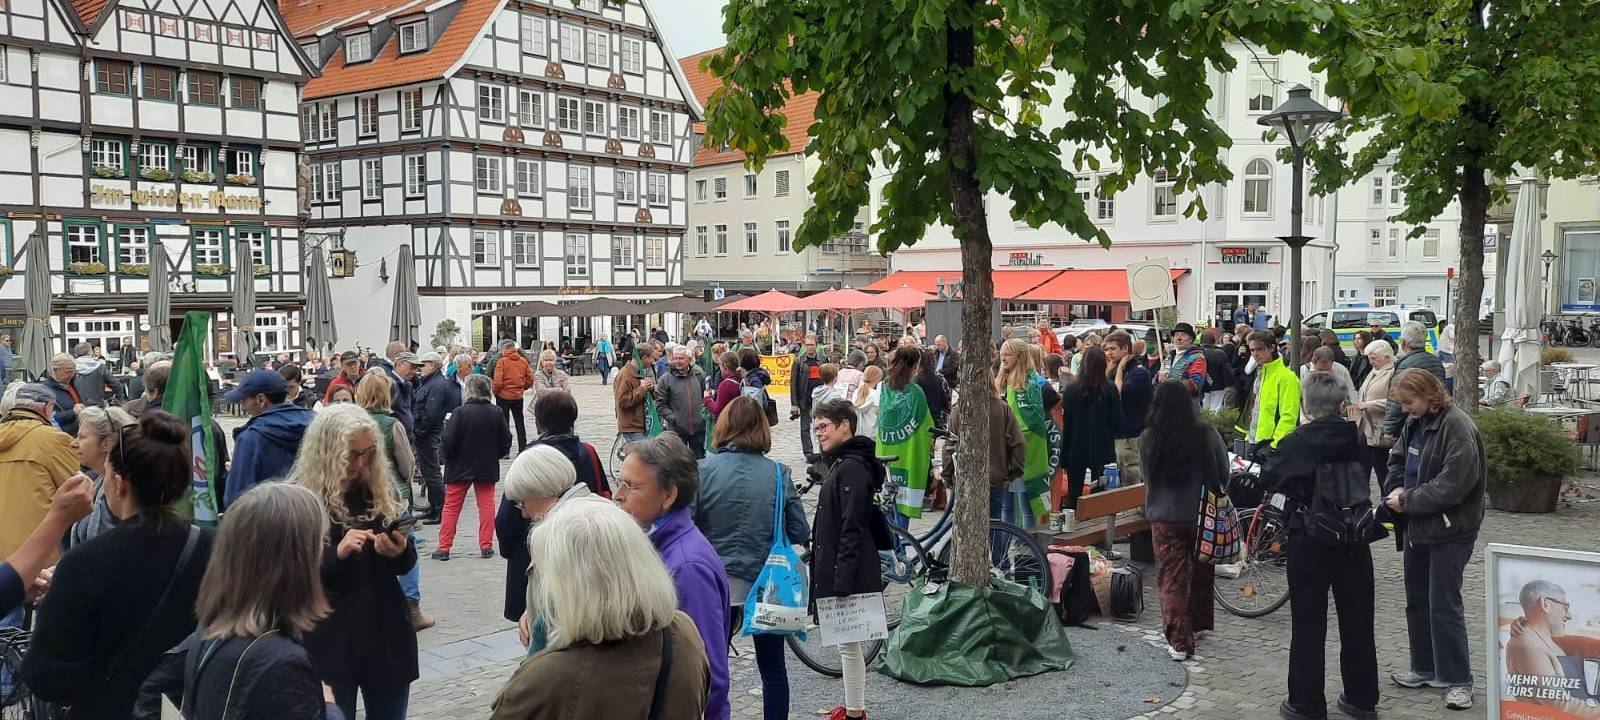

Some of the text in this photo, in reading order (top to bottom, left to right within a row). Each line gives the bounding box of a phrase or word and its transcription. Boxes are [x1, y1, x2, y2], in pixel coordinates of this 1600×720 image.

[1222, 248, 1270, 265] extrablatt
[880, 418, 919, 443] UTURE
[1045, 419, 1061, 443] AYS
[1506, 674, 1539, 686] MEHR
[1506, 683, 1571, 701] FÜRS LEBEN
